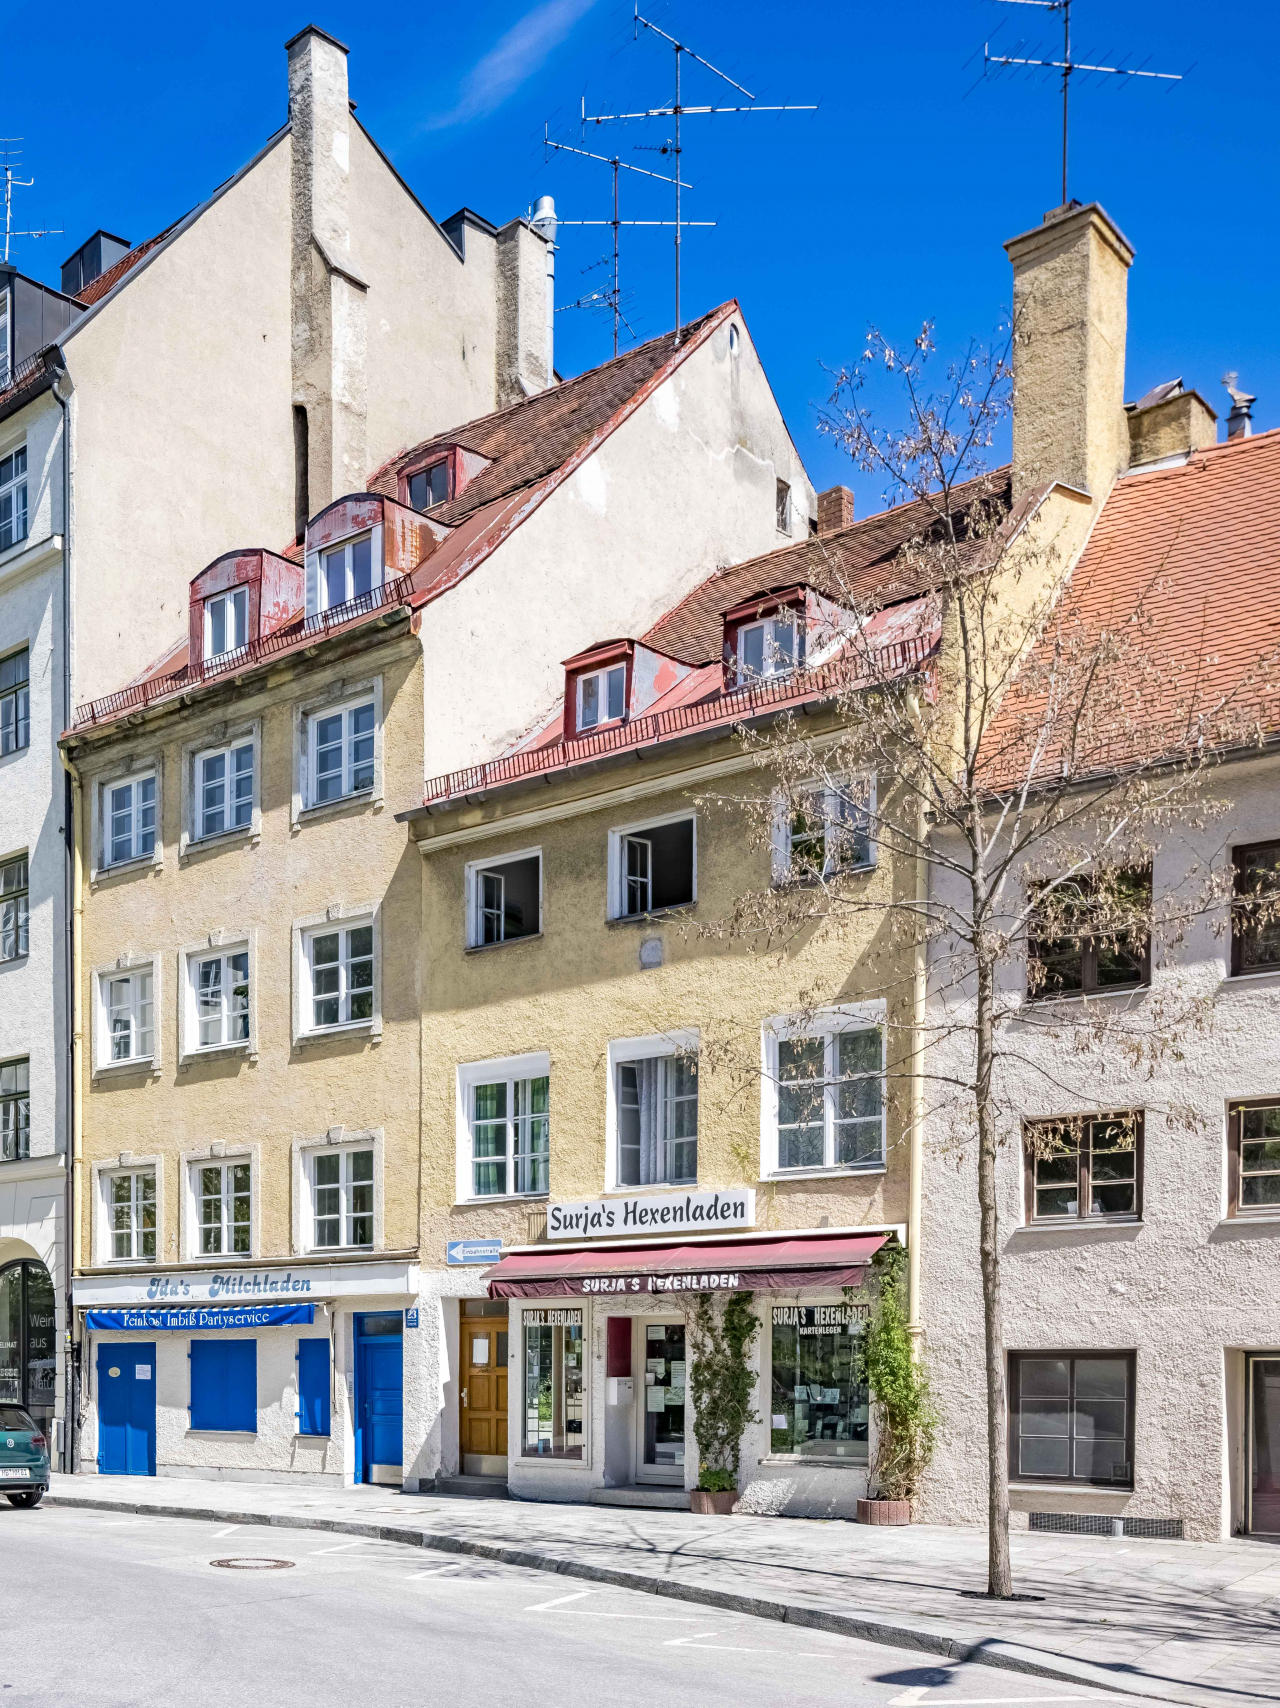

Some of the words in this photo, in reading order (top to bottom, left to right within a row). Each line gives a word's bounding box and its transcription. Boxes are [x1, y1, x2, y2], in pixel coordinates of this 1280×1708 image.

[550, 1203, 615, 1235] Surja's
[623, 1194, 745, 1227] Hexenladen
[462, 1247, 499, 1255] Einbahnstraße
[146, 1277, 190, 1299] Ida's
[209, 1273, 311, 1298] Milchladen
[648, 1273, 739, 1291] HEXENLADEN
[29, 1313, 55, 1328] Wein
[123, 1312, 163, 1327] Feinkost
[167, 1312, 197, 1326] Imbiß
[199, 1310, 269, 1329] Partyservice
[407, 1310, 417, 1319] 23
[547, 1309, 582, 1327] HEXENLADEN
[814, 1305, 870, 1325] HEXENLADEN
[800, 1326, 842, 1336] KARTENLEGEN
[29, 1338, 47, 1348] aus
